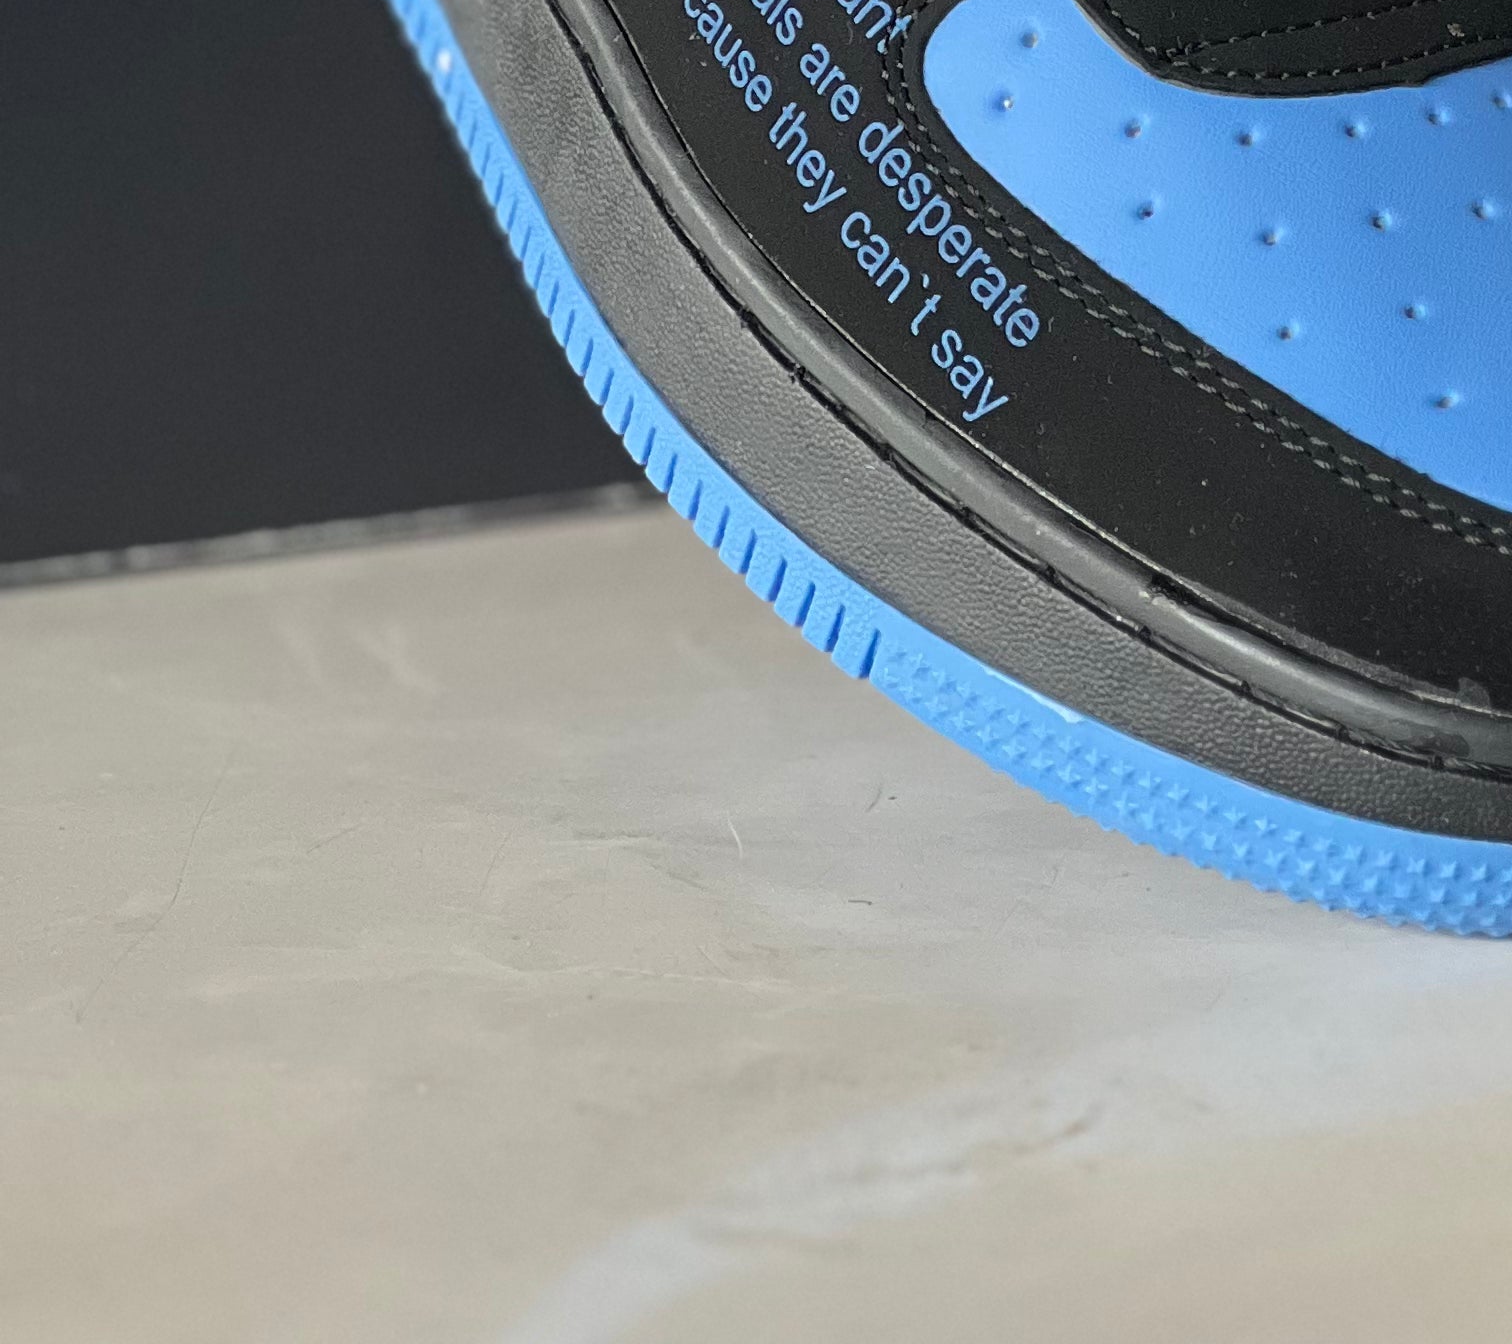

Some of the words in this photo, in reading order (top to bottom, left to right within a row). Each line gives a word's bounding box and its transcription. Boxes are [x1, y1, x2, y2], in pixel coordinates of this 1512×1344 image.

[768, 102, 848, 214] they
[931, 328, 1010, 423] say
[800, 42, 861, 123] are
[858, 120, 1041, 348] desperate
